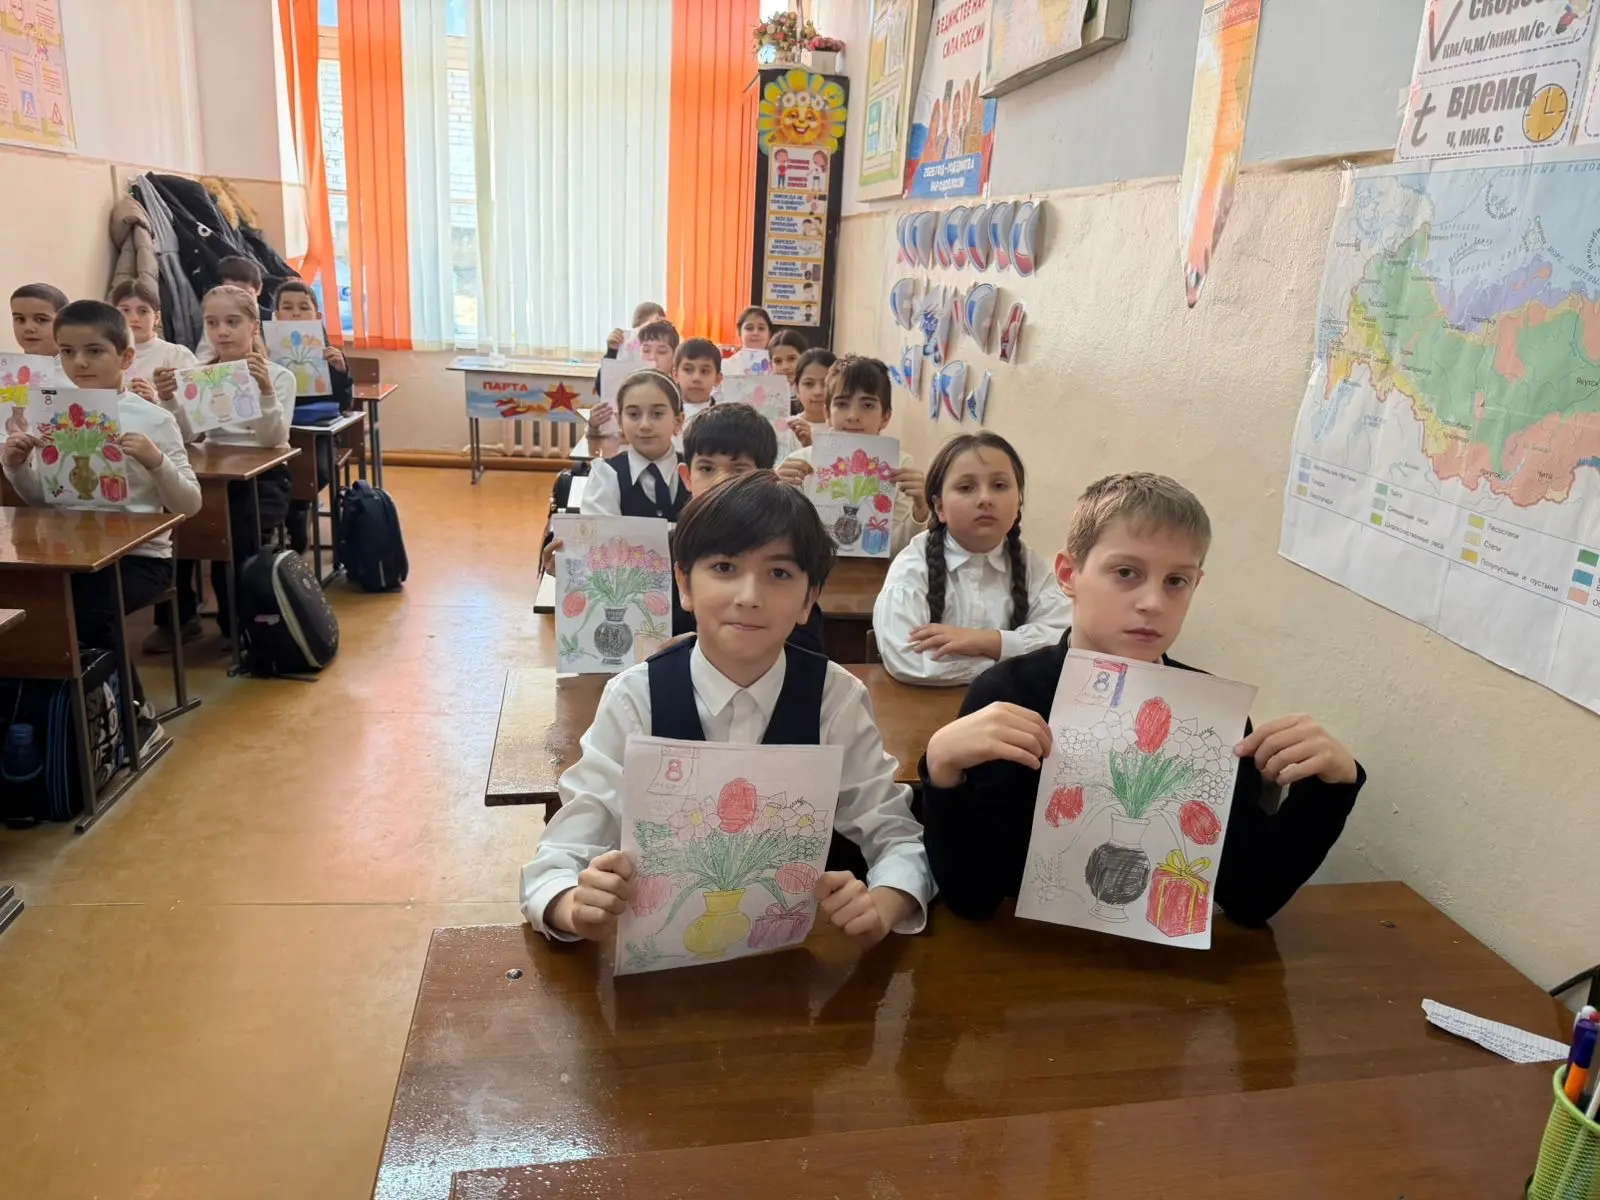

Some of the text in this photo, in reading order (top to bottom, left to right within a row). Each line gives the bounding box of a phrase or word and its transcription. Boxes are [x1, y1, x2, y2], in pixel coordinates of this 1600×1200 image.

[1446, 73, 1538, 121] время
[1411, 92, 1437, 148] t
[1493, 125, 1505, 144] с
[482, 381, 529, 392] ПАРТА
[45, 395, 53, 405] 8
[1483, 540, 1502, 552] Степи
[1529, 577, 1559, 593] пустыни
[1093, 671, 1111, 693] 8
[664, 759, 683, 782] 8
